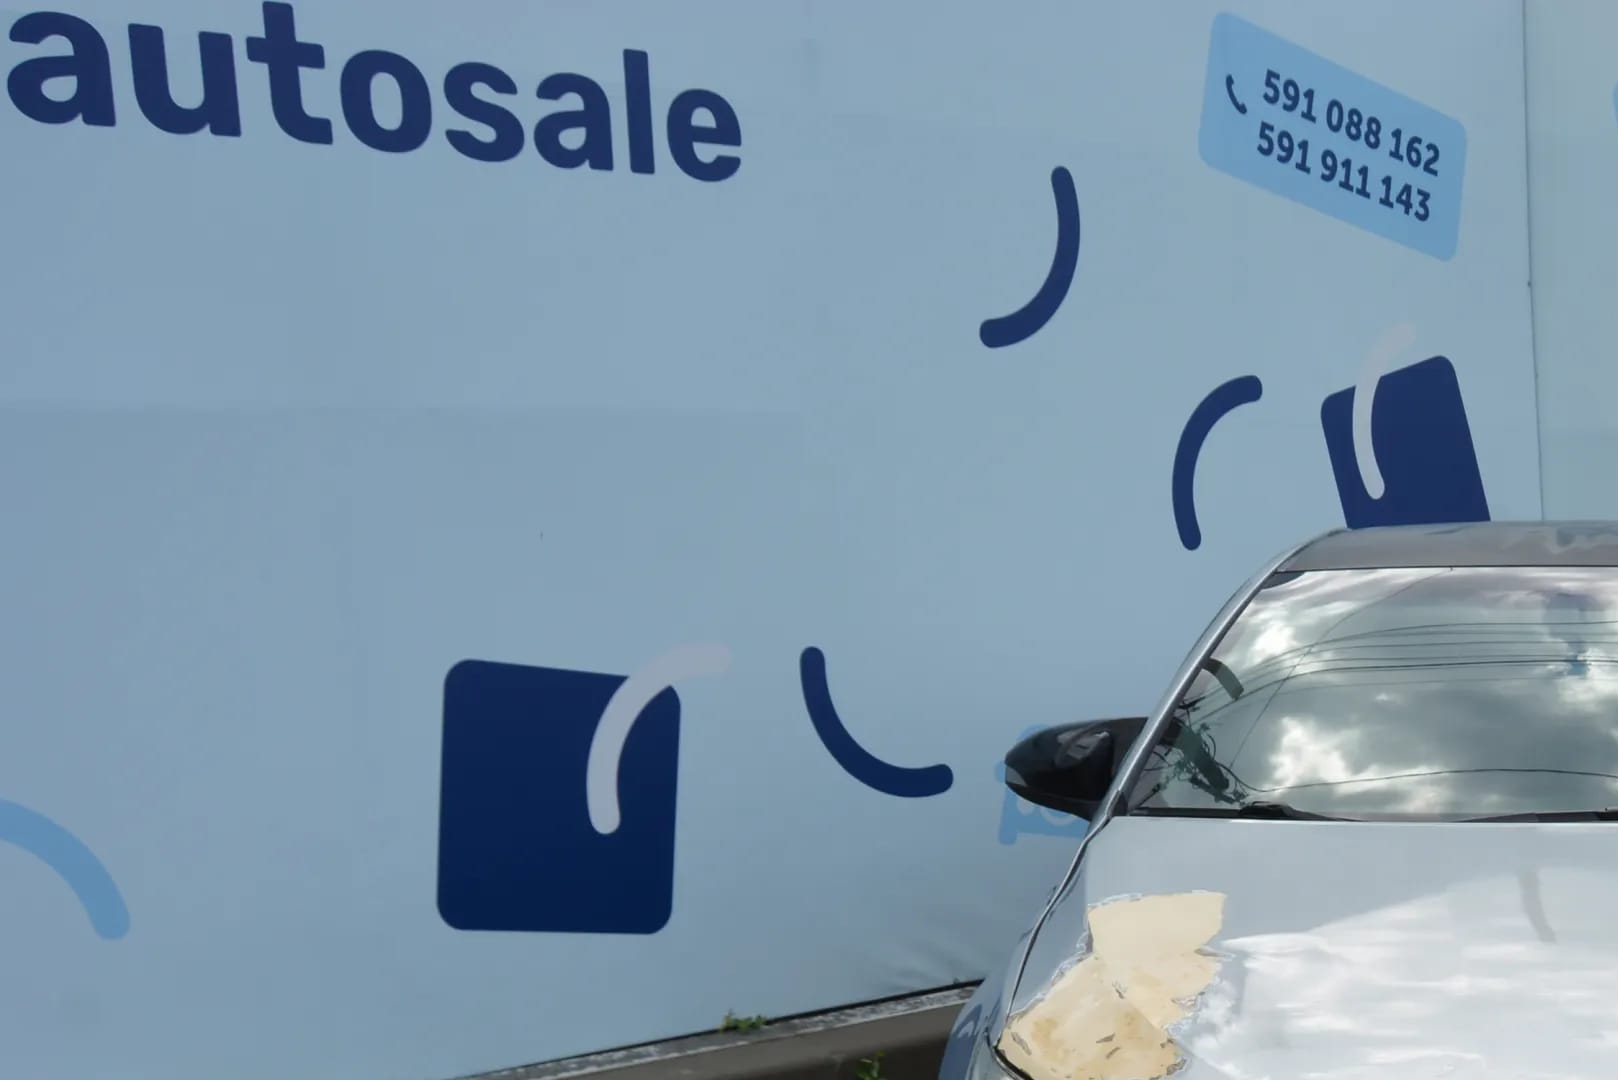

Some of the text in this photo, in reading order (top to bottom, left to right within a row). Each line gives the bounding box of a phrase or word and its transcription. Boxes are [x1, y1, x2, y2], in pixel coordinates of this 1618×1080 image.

[7, 1, 742, 182] autosale
[1262, 69, 1440, 177] 591 088 162
[1257, 121, 1431, 222] 591 911 143
